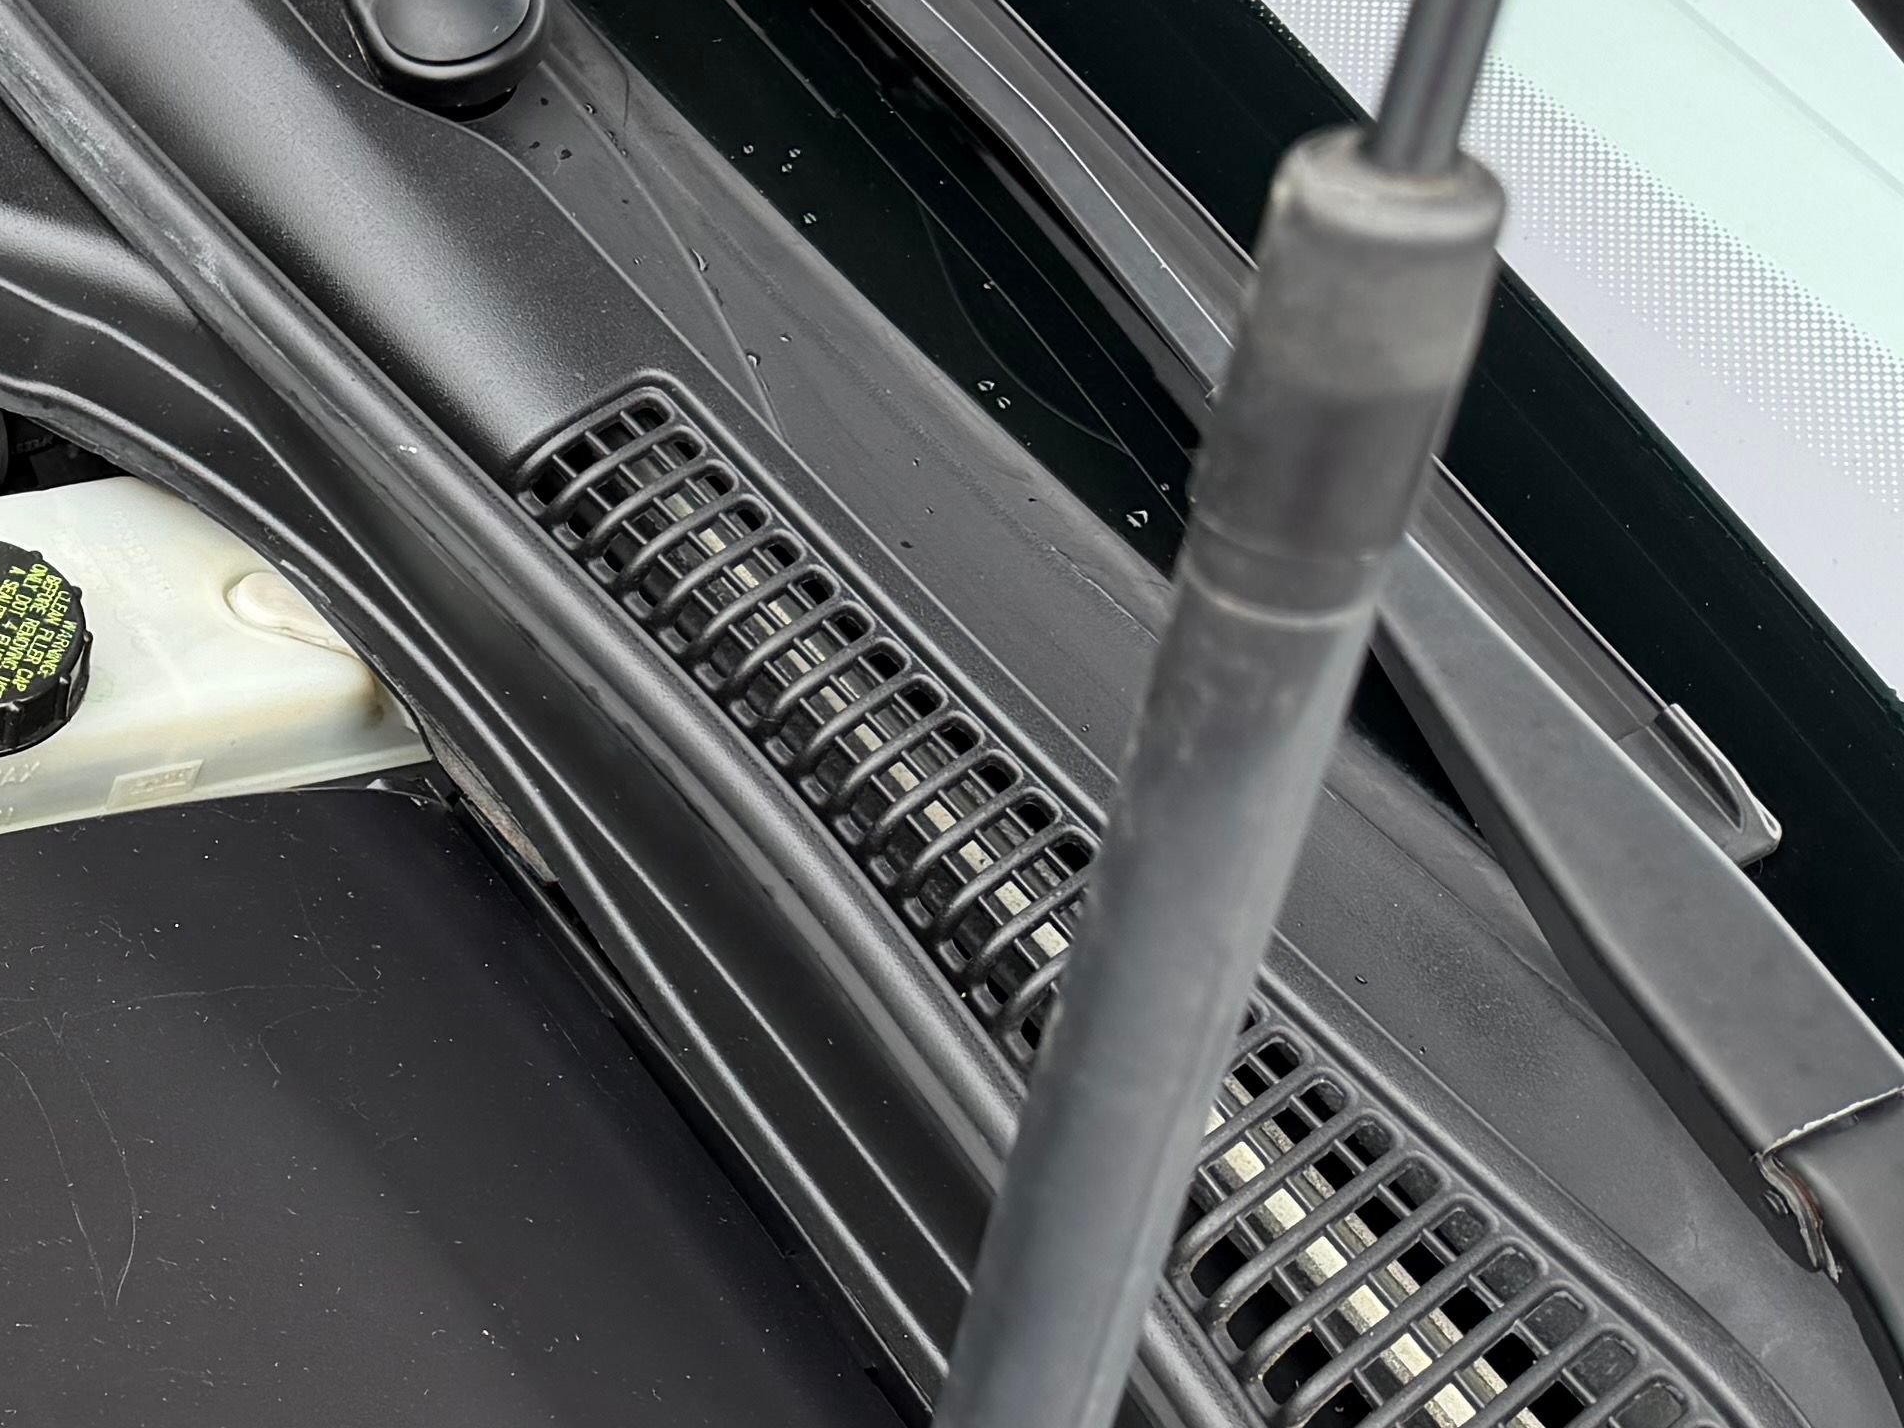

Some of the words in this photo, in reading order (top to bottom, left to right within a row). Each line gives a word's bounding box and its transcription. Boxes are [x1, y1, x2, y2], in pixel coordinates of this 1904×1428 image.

[8, 565, 25, 576] A
[21, 561, 47, 591] ONLY
[7, 593, 31, 617] DOT
[28, 573, 61, 615] BEFORE
[44, 589, 73, 625] CLEAN
[2, 620, 17, 631] 4
[23, 627, 54, 665] FILLER
[36, 618, 79, 679] WARNING:
[9, 667, 33, 692] CAP
